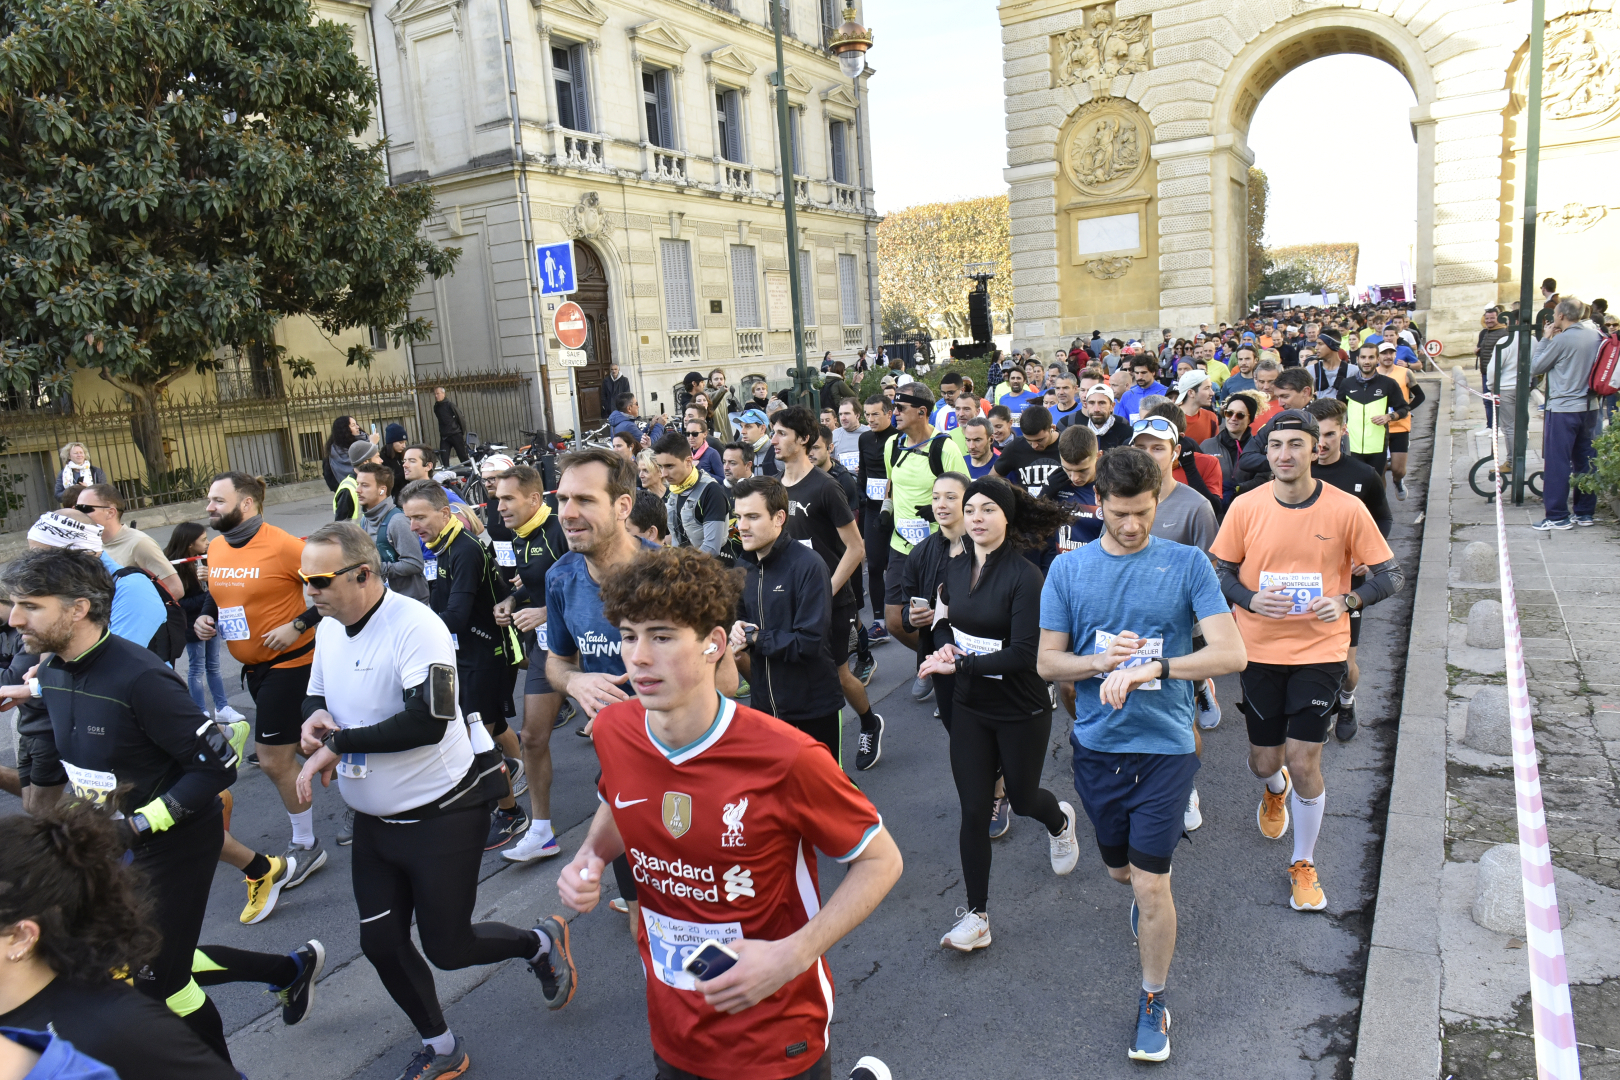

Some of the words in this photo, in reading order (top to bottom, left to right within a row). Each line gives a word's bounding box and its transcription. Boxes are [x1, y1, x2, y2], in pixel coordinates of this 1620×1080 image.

[1018, 464, 1061, 486] NIK
[901, 528, 924, 538] 980
[209, 566, 260, 579] HITACHI
[584, 630, 608, 643] Teads
[966, 642, 999, 652] MONTPELLIER
[1311, 699, 1329, 707] GORE
[87, 725, 105, 733] GORE
[77, 777, 114, 788] MONTPELLIER
[670, 819, 683, 828] FIFA
[630, 847, 715, 882] Standard
[632, 864, 719, 903] Chartered
[668, 921, 684, 931] Les
[688, 925, 700, 934] 20
[705, 927, 720, 935] km
[725, 926, 738, 934] de
